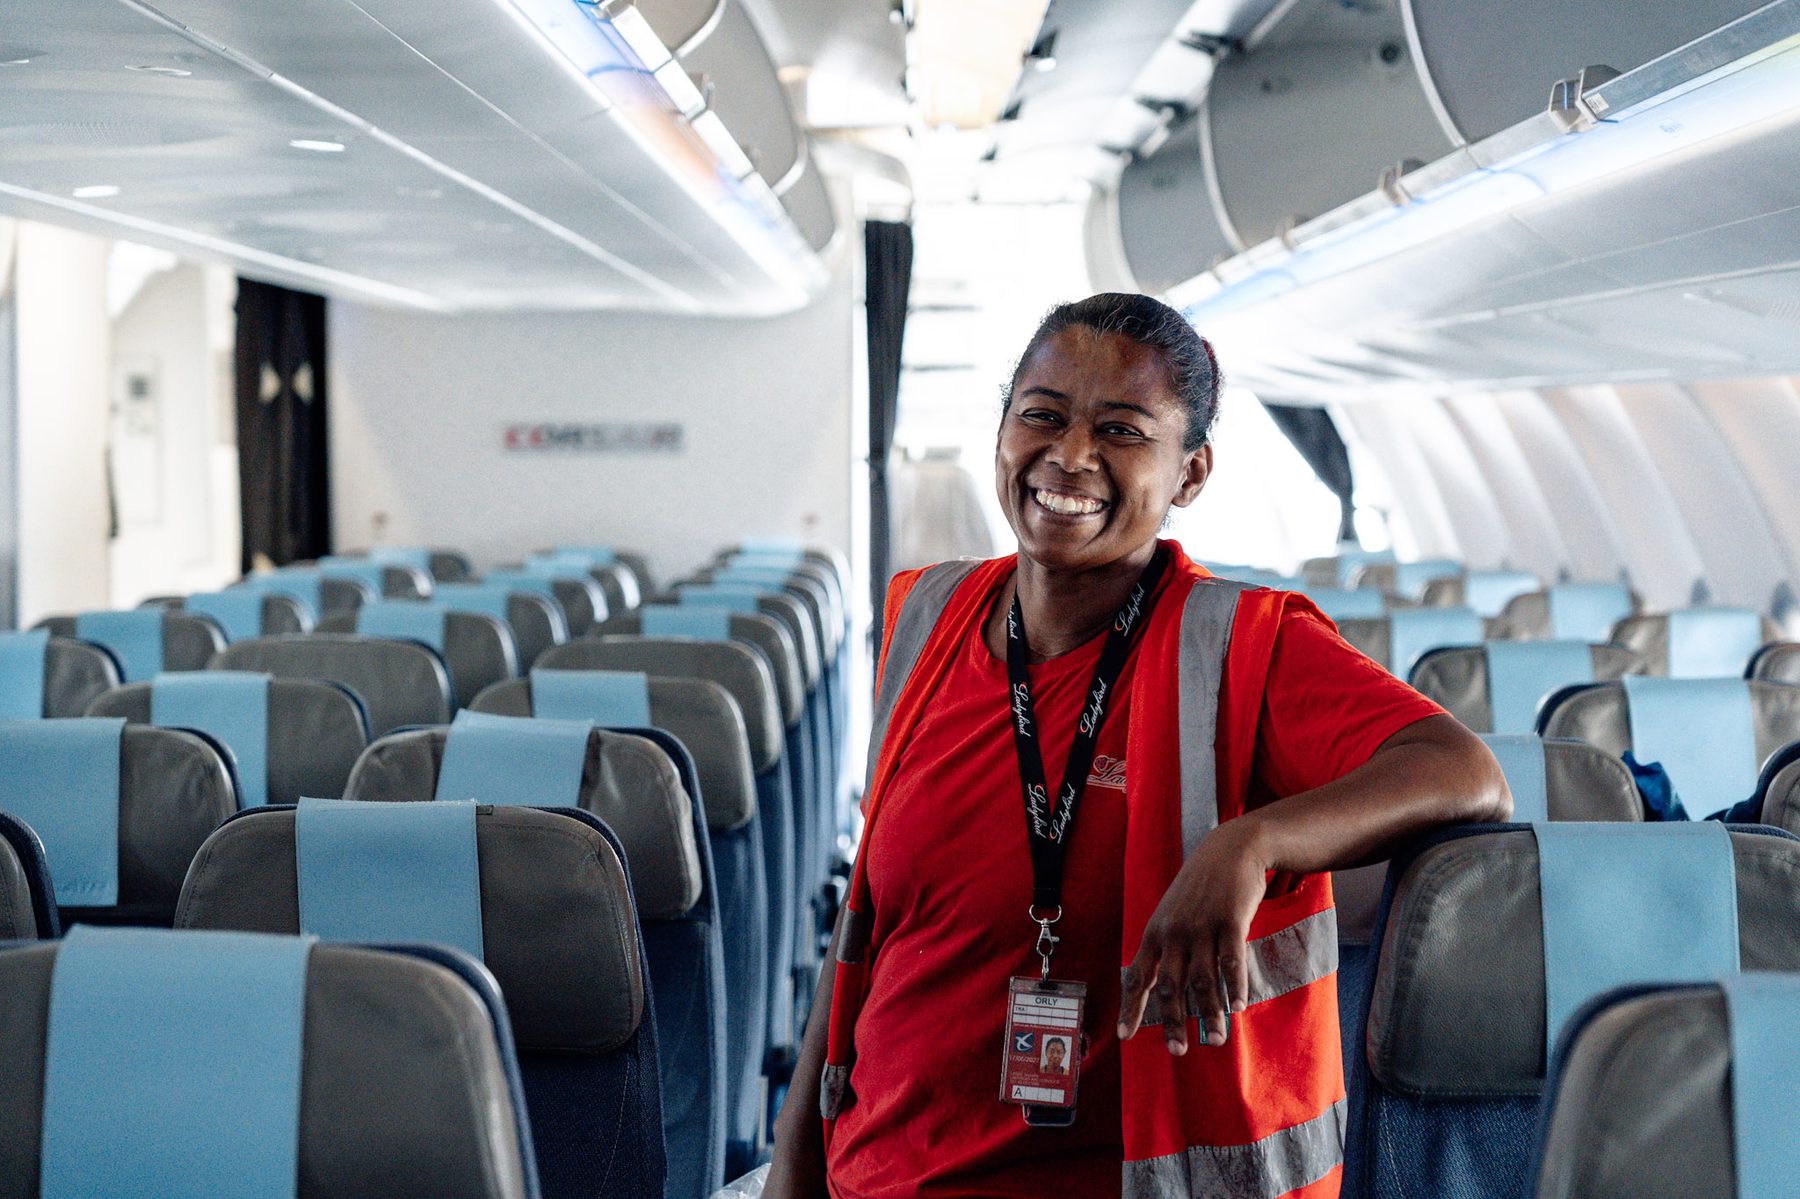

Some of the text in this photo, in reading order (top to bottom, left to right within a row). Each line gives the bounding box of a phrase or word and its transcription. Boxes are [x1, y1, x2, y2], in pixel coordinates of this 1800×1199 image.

[1008, 598, 1018, 640] dybird
[1115, 582, 1145, 637] Ladybird
[1013, 681, 1031, 737] Ladybird
[1079, 677, 1107, 738] Ladybird
[1027, 783, 1047, 839] Ladybird
[1050, 783, 1076, 844] Ladybird
[1034, 997, 1058, 1006] ORLY
[1013, 1087, 1023, 1097] A
